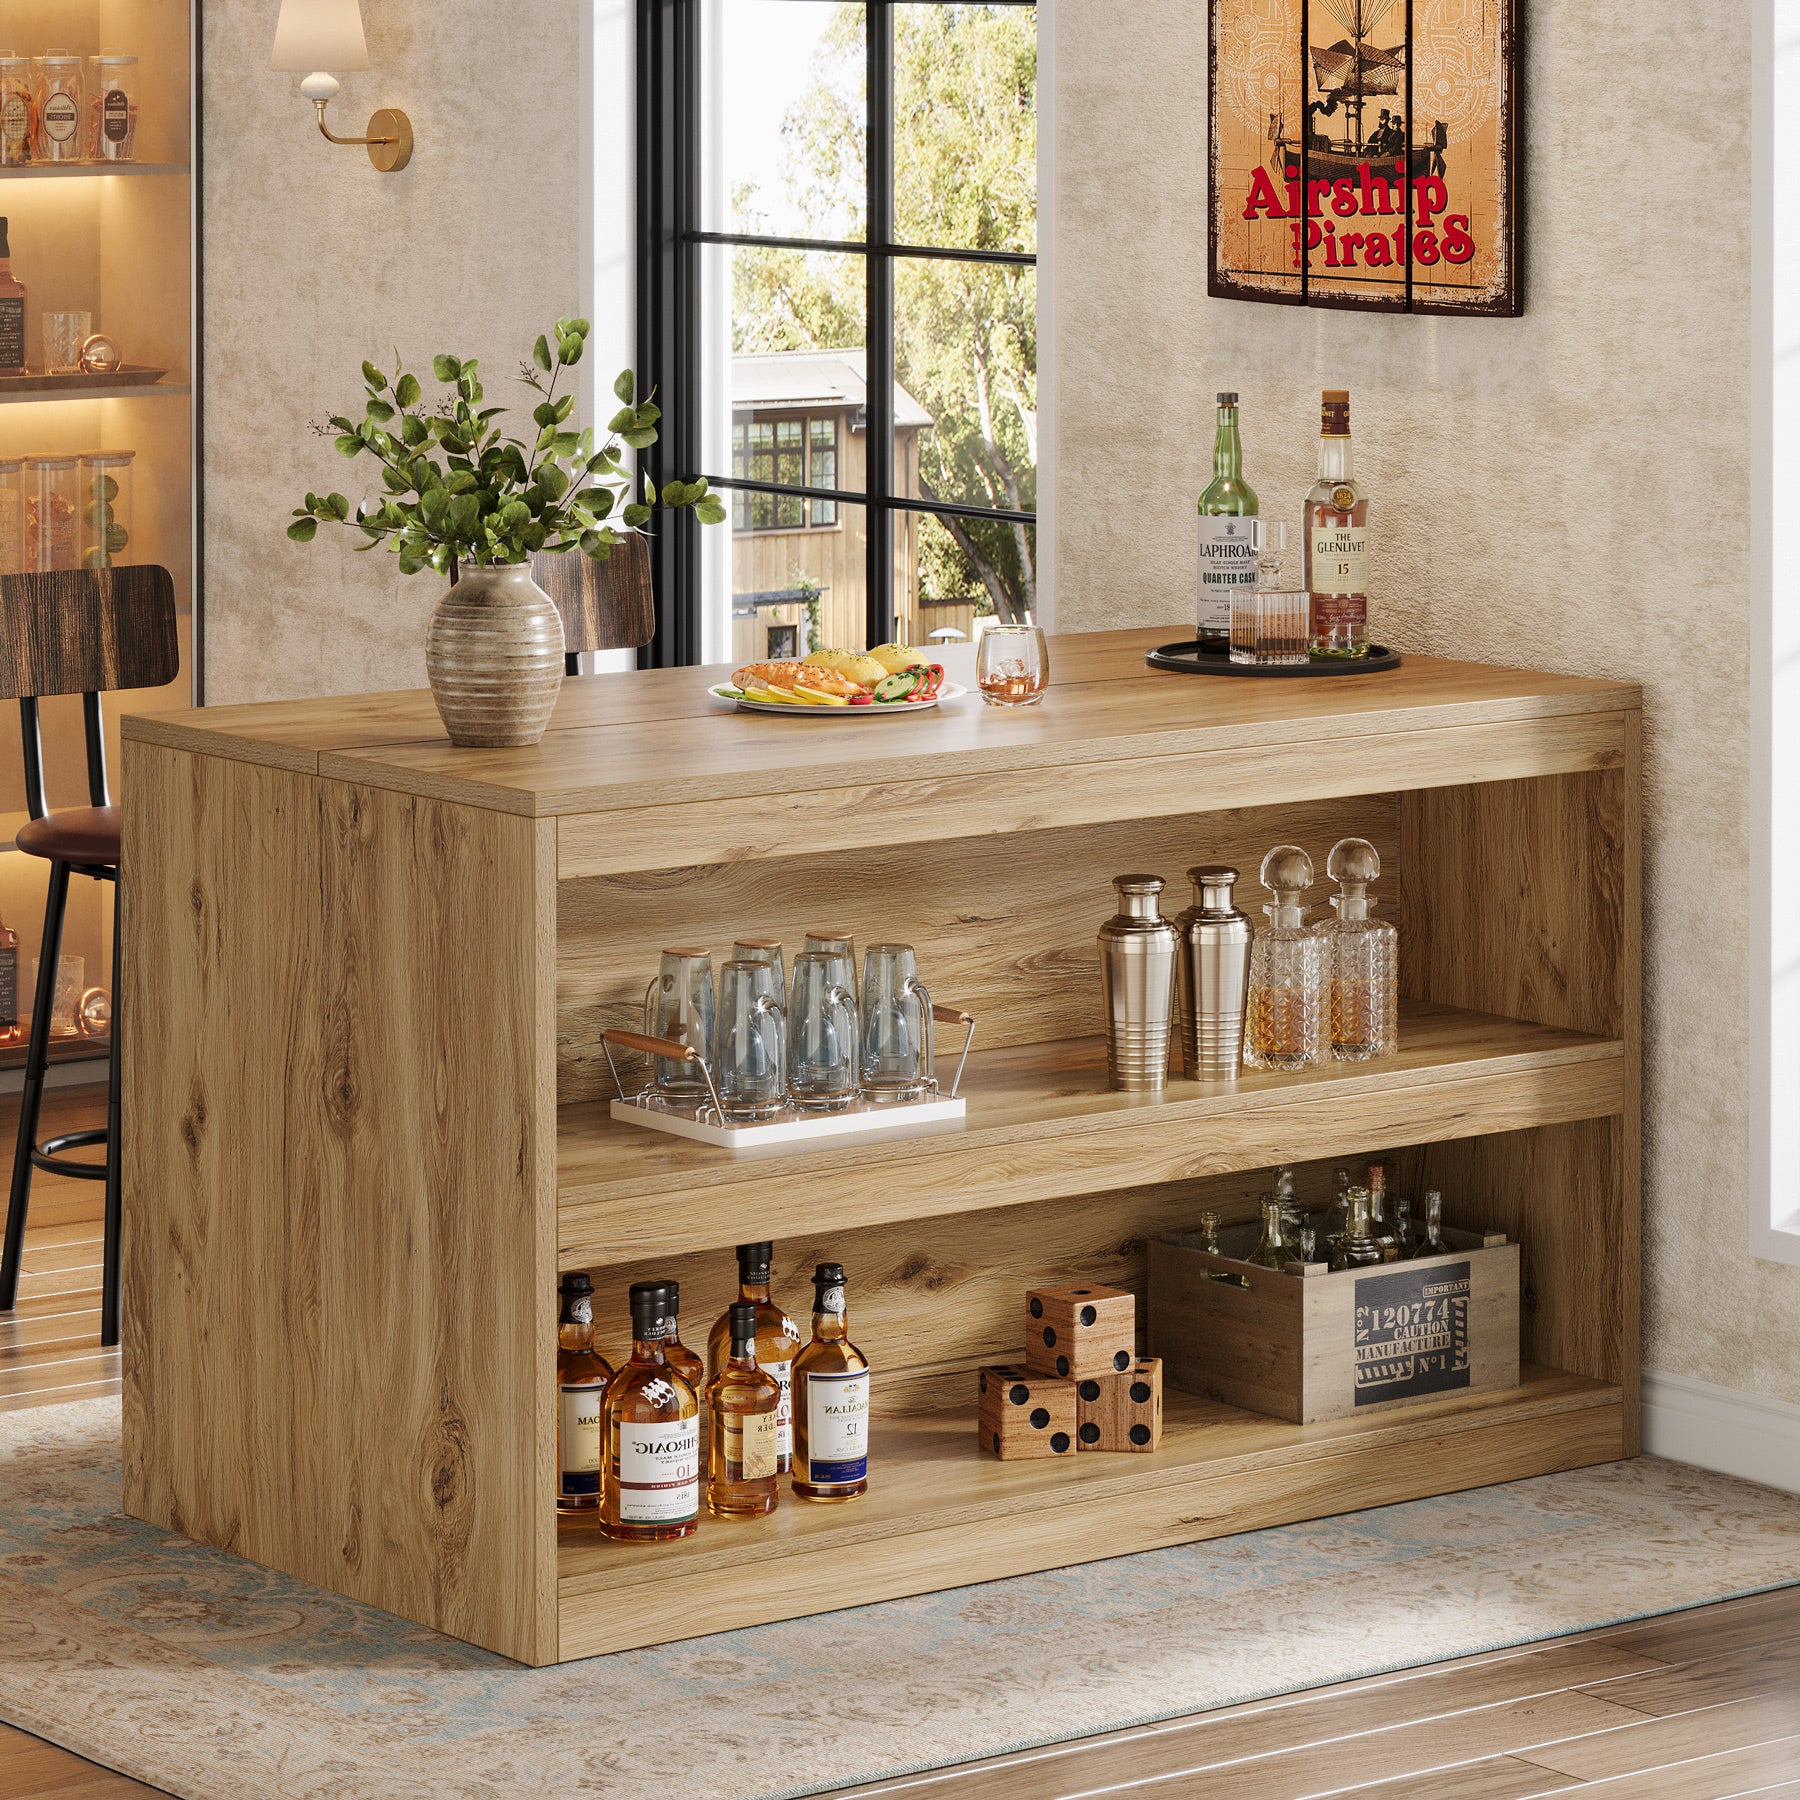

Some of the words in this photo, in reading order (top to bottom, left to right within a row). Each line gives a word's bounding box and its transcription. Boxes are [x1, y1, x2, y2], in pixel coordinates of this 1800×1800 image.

[1242, 161, 1448, 227] Airship
[1335, 533, 1351, 541] THE
[1317, 541, 1366, 553] GLENLIVET
[1338, 563, 1349, 575] 15
[1203, 572, 1237, 584] QUARTER
[1239, 572, 1256, 584] CASK
[1424, 1281, 1469, 1296] IMPORTANT
[1372, 1298, 1450, 1331] 120774
[1393, 1319, 1450, 1340] CAUTION
[1356, 1333, 1450, 1361] MANUFACTURE
